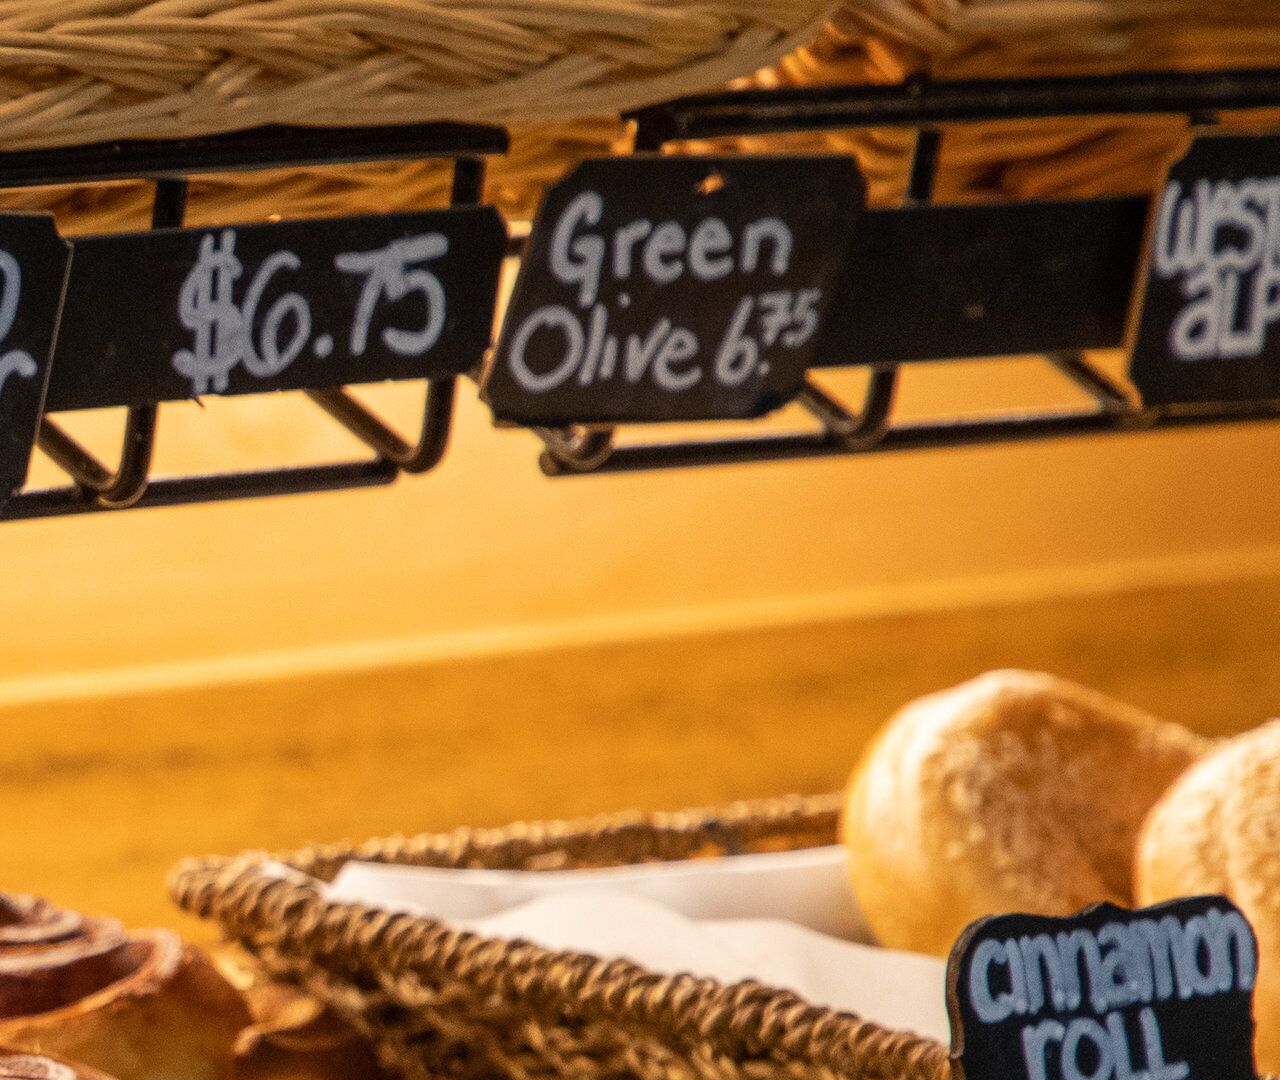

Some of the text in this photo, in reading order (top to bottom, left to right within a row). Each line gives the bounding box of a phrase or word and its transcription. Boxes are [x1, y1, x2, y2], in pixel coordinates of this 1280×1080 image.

[549, 190, 793, 307] Green
[173, 230, 448, 394] $6.75
[508, 287, 824, 394] Olive 6.75
